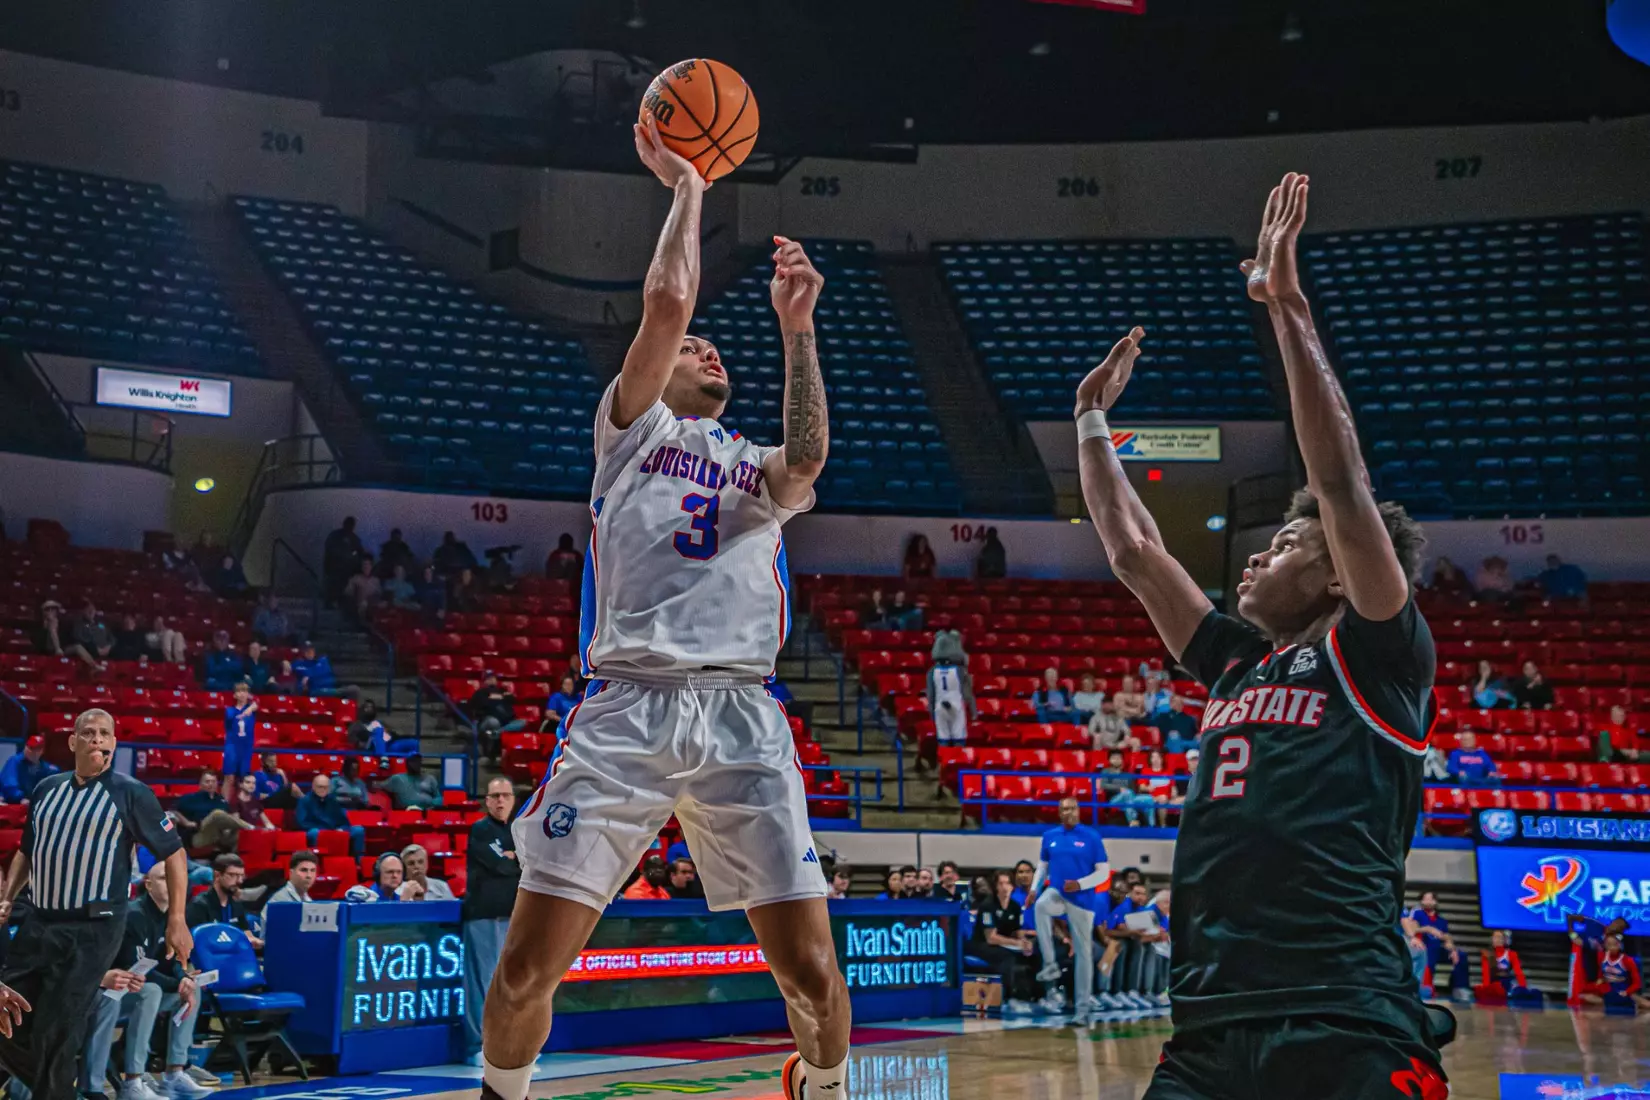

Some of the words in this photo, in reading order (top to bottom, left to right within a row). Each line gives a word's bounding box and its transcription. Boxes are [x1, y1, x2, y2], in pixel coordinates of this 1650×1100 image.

[260, 131, 303, 154] 204
[1435, 156, 1482, 179] 207
[800, 176, 841, 197] 205
[1057, 177, 1099, 198] 206
[128, 387, 154, 398] Willis
[155, 389, 197, 402] Knighton
[471, 502, 507, 523] 103
[673, 492, 720, 561] 3
[950, 524, 987, 542] 104
[1500, 525, 1544, 545] 105
[1288, 660, 1317, 675] USA
[238, 720, 246, 737] 1
[1211, 735, 1251, 800] 2
[846, 922, 890, 957] Ivan
[891, 920, 946, 956] Smith
[356, 937, 433, 982] Ivan
[586, 954, 637, 971] OFFICIAL
[641, 951, 694, 968] FURNITURE
[696, 951, 727, 966] STORE
[728, 950, 741, 964] OF
[742, 949, 755, 963] LA
[846, 961, 947, 987] FURNITURE
